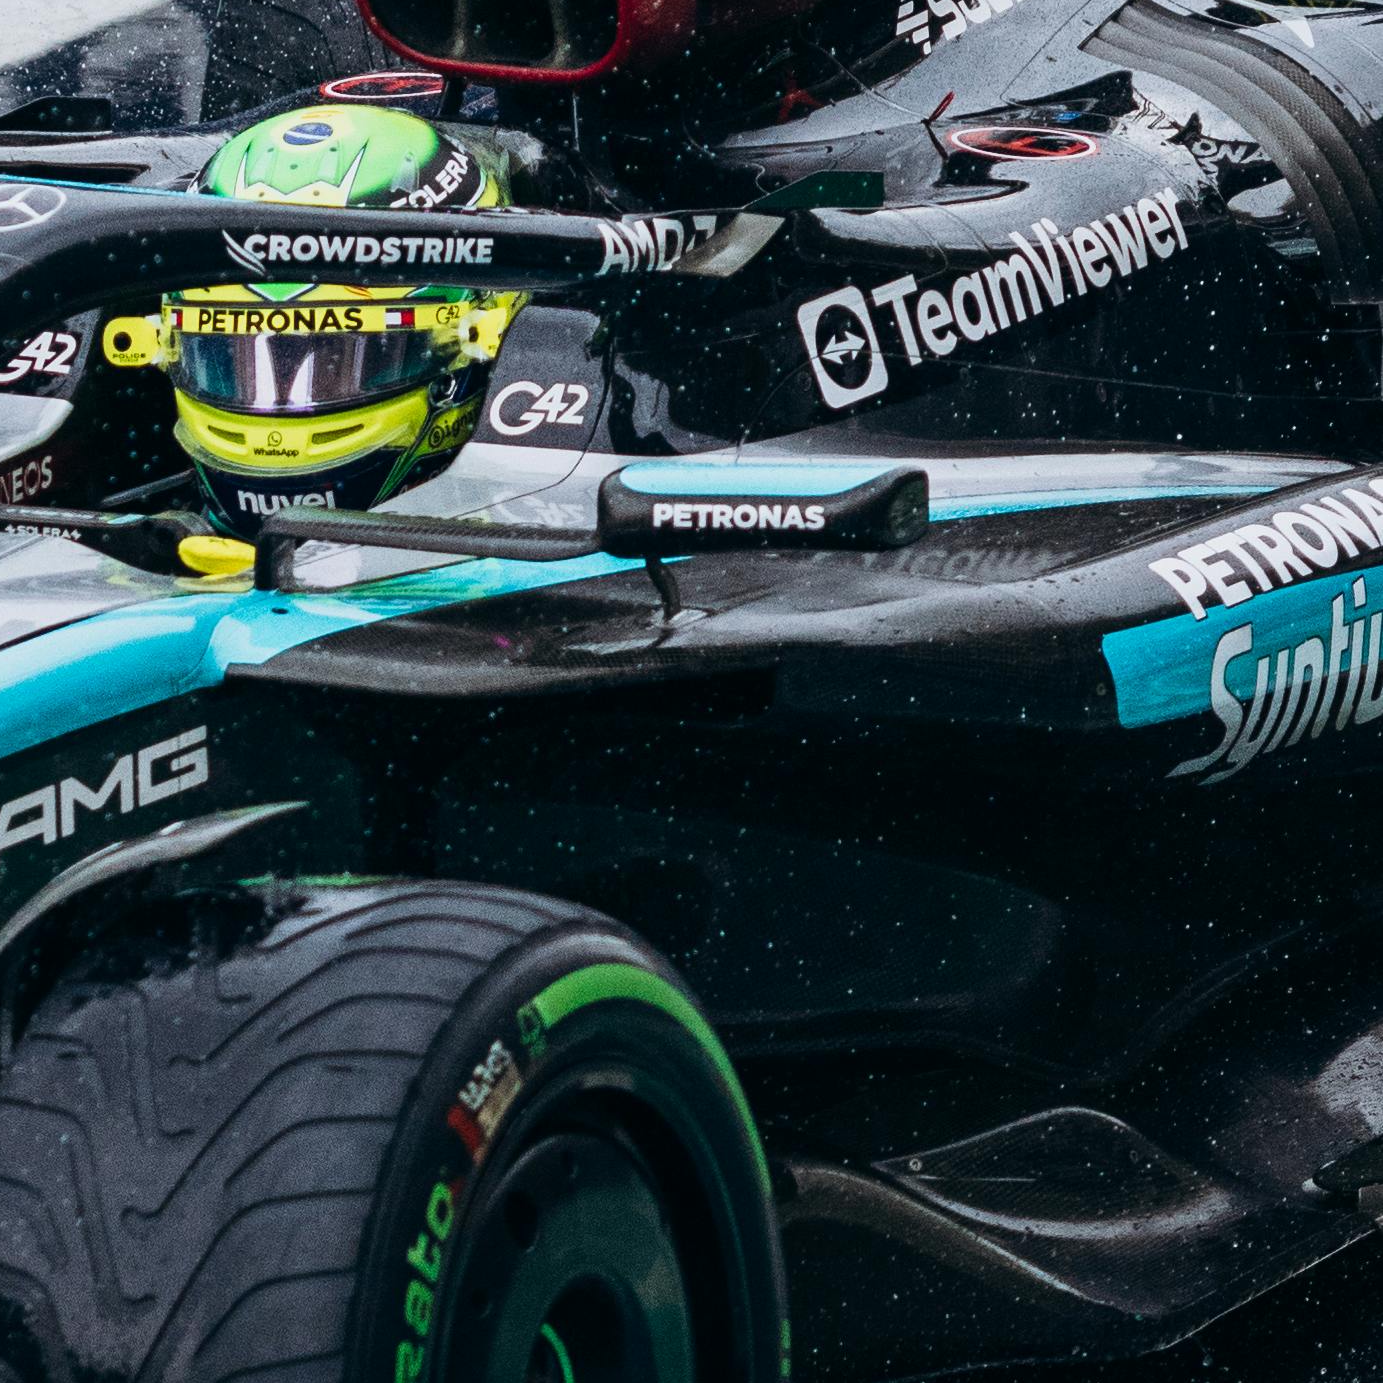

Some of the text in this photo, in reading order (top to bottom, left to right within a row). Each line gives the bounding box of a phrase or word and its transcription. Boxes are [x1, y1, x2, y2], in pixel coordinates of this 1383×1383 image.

[390, 150, 469, 208] OLERA
[244, 234, 494, 264] CROWDSTRIKE
[594, 218, 685, 277] AMD
[872, 187, 1189, 366] TeamViewer
[199, 308, 364, 334] PETRONAS
[489, 380, 589, 436] G42
[253, 447, 300, 458] WhatsApp
[652, 502, 826, 531] PETRONAS
